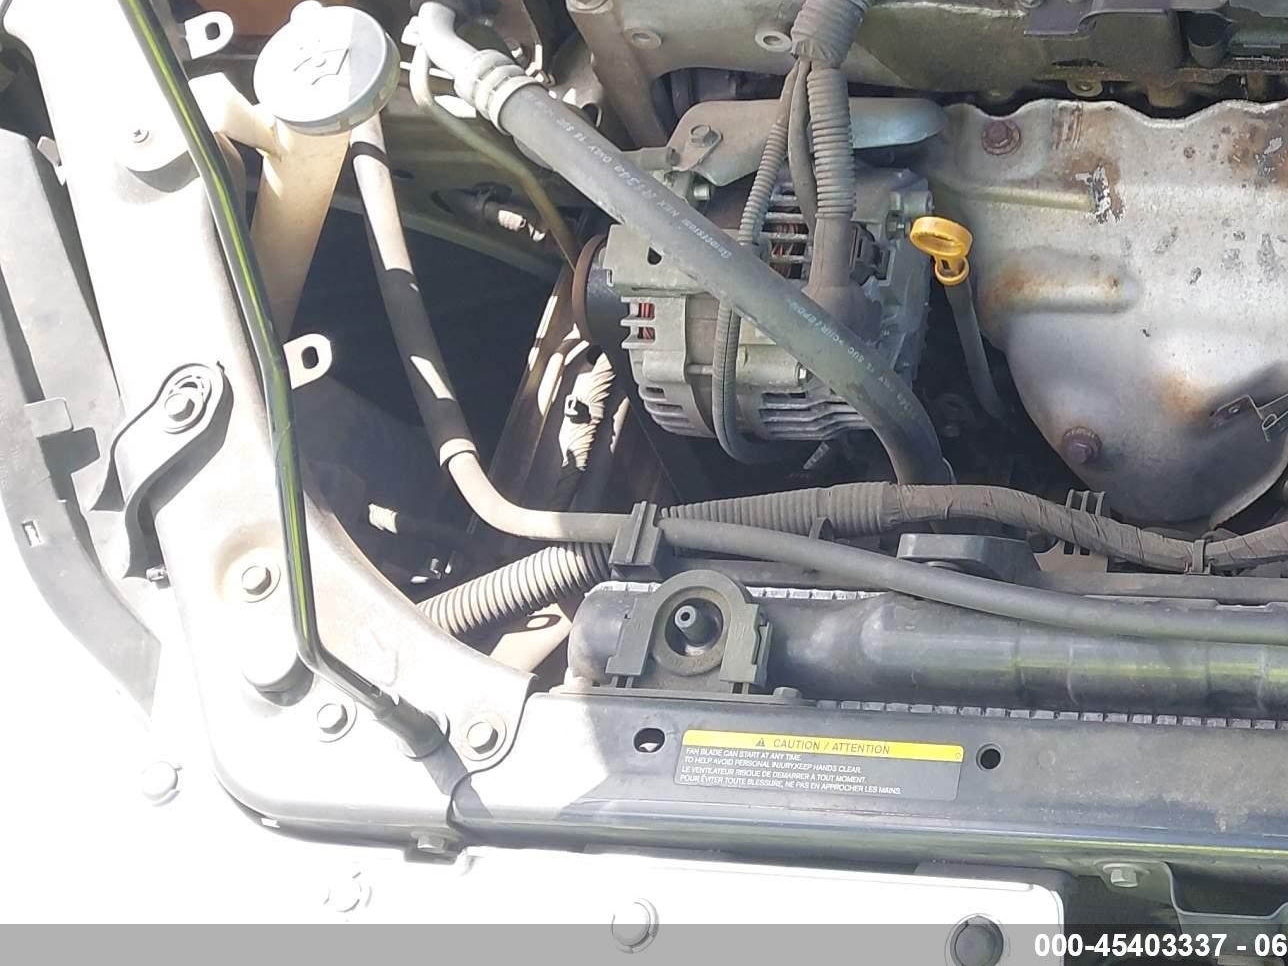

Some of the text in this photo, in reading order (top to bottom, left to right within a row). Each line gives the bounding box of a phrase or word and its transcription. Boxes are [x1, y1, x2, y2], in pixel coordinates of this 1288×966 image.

[701, 748, 722, 756] BLADE
[774, 739, 820, 750] CAUTION
[832, 743, 890, 754] ATTENTION
[735, 759, 769, 768] PERSONAL
[813, 764, 837, 772] HANDS
[736, 769, 760, 777] RISQUE
[726, 777, 746, 785] TOUTE
[821, 784, 864, 792] APPROCHER
